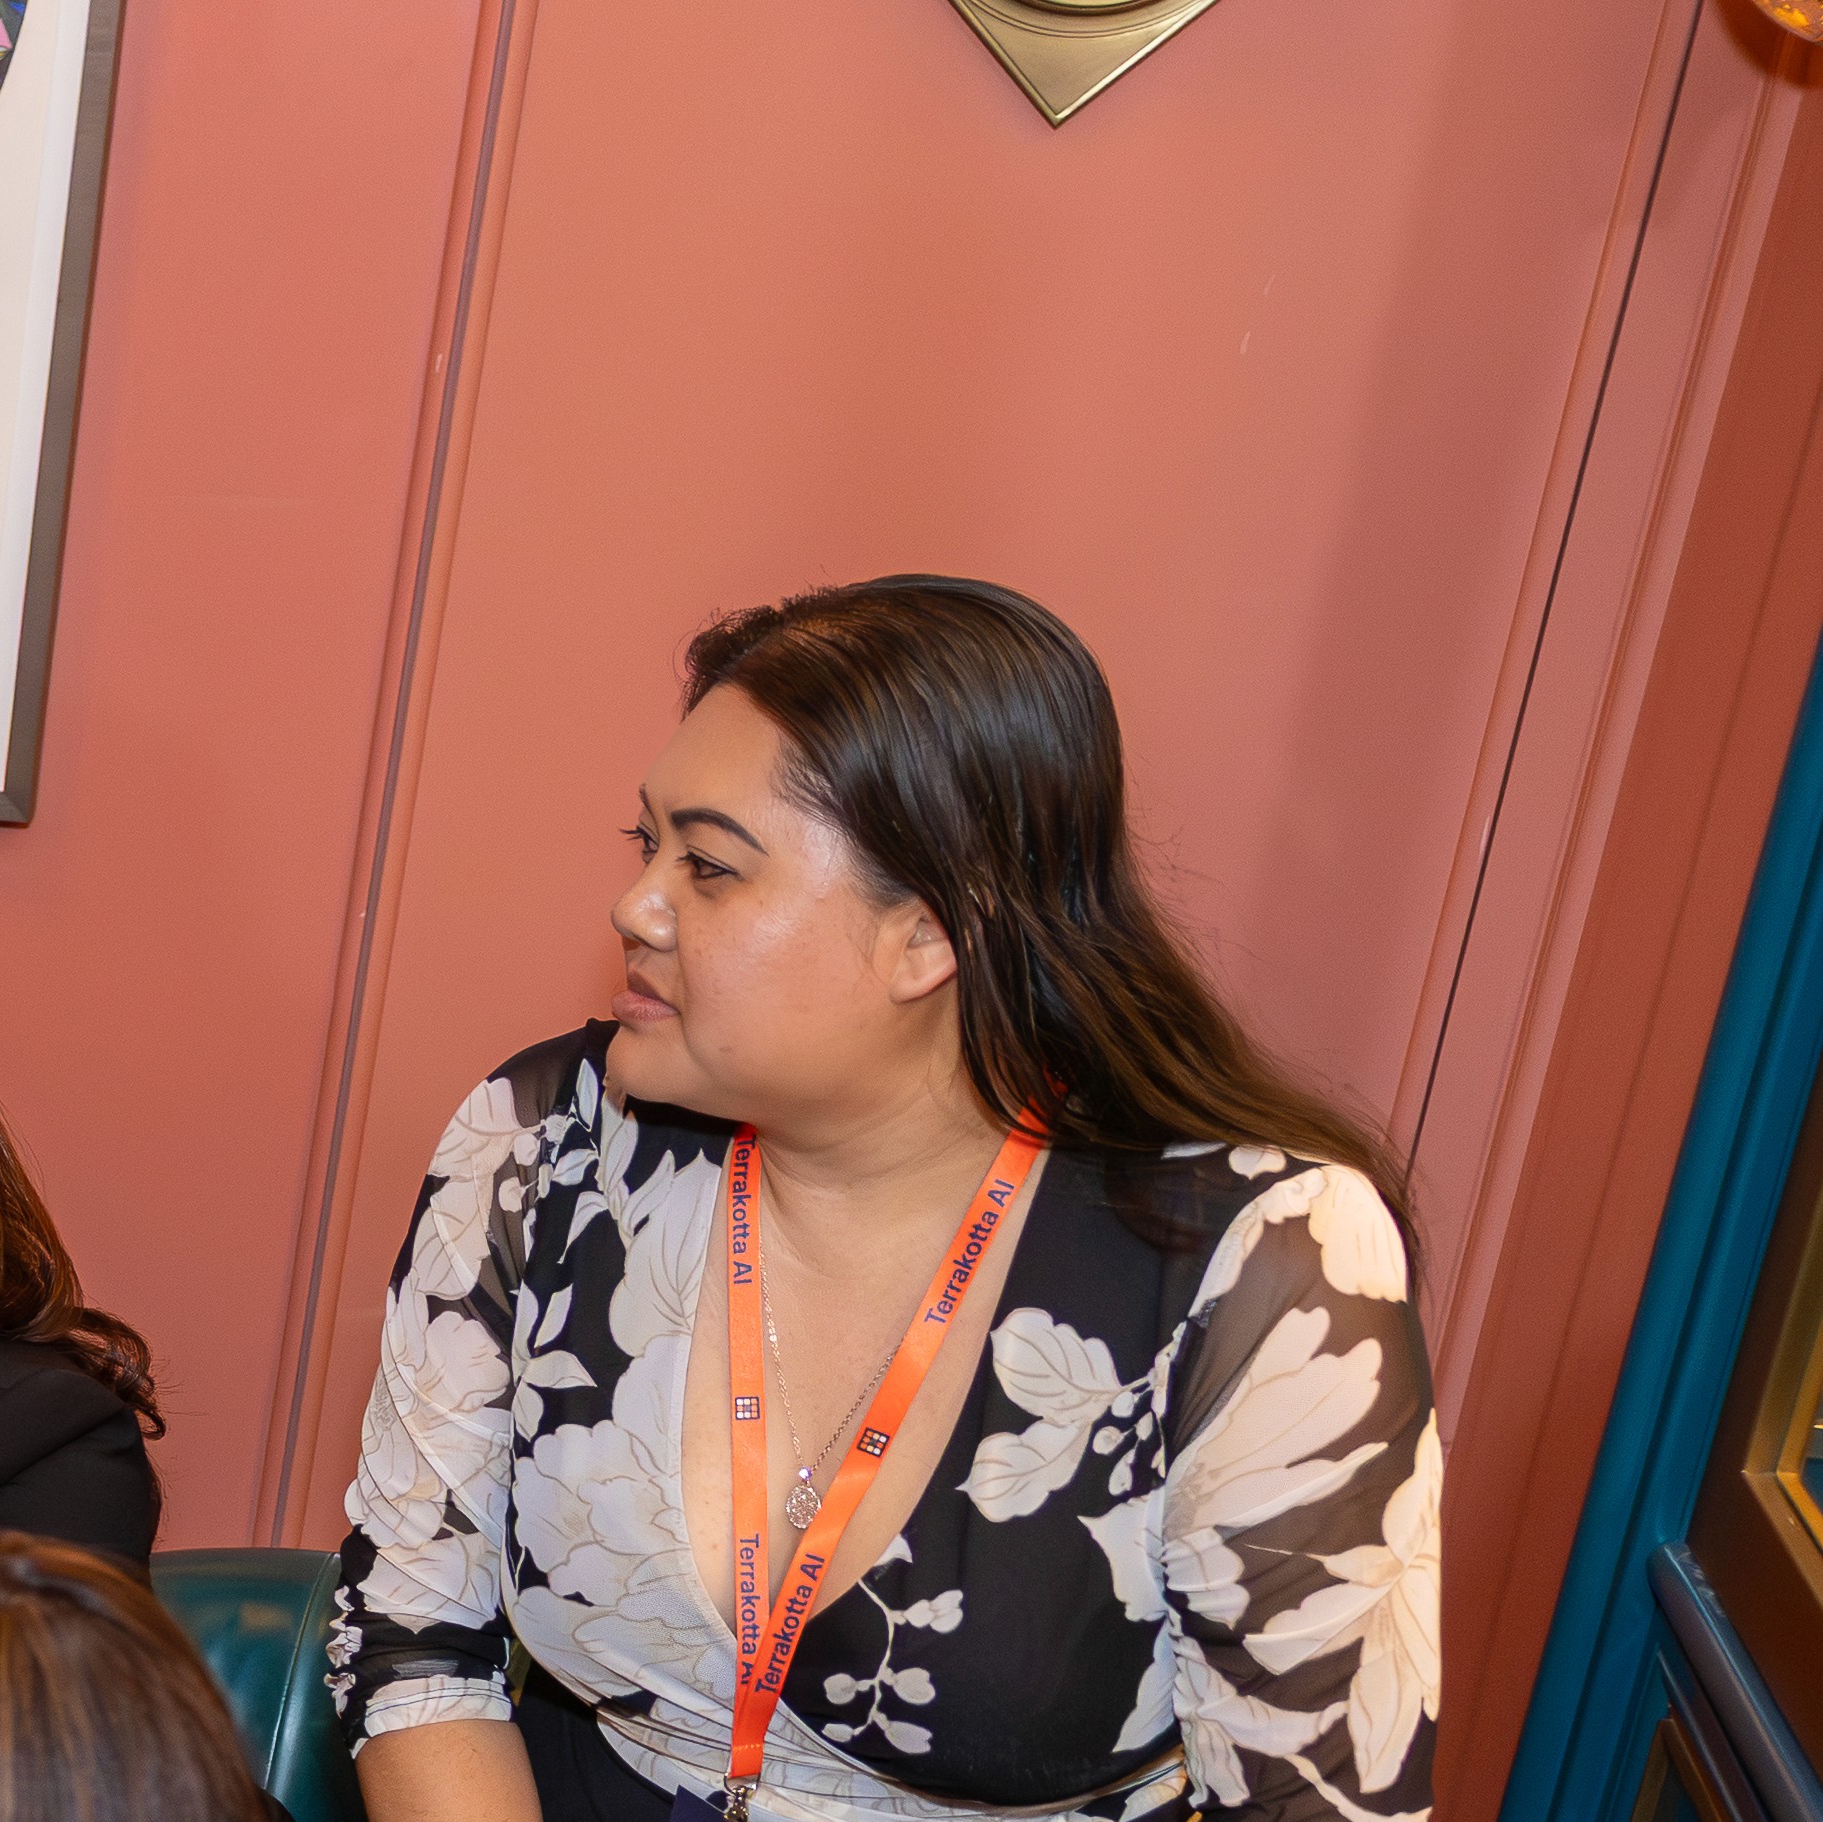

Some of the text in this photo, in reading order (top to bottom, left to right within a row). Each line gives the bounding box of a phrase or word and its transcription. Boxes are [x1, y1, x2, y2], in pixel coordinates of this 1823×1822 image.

[733, 1133, 757, 1284] Terrakotta AI
[924, 1178, 1015, 1323] Terrakotta AI
[739, 1533, 761, 1656] Terrakotta
[755, 1553, 825, 1694] Terrakotta AI
